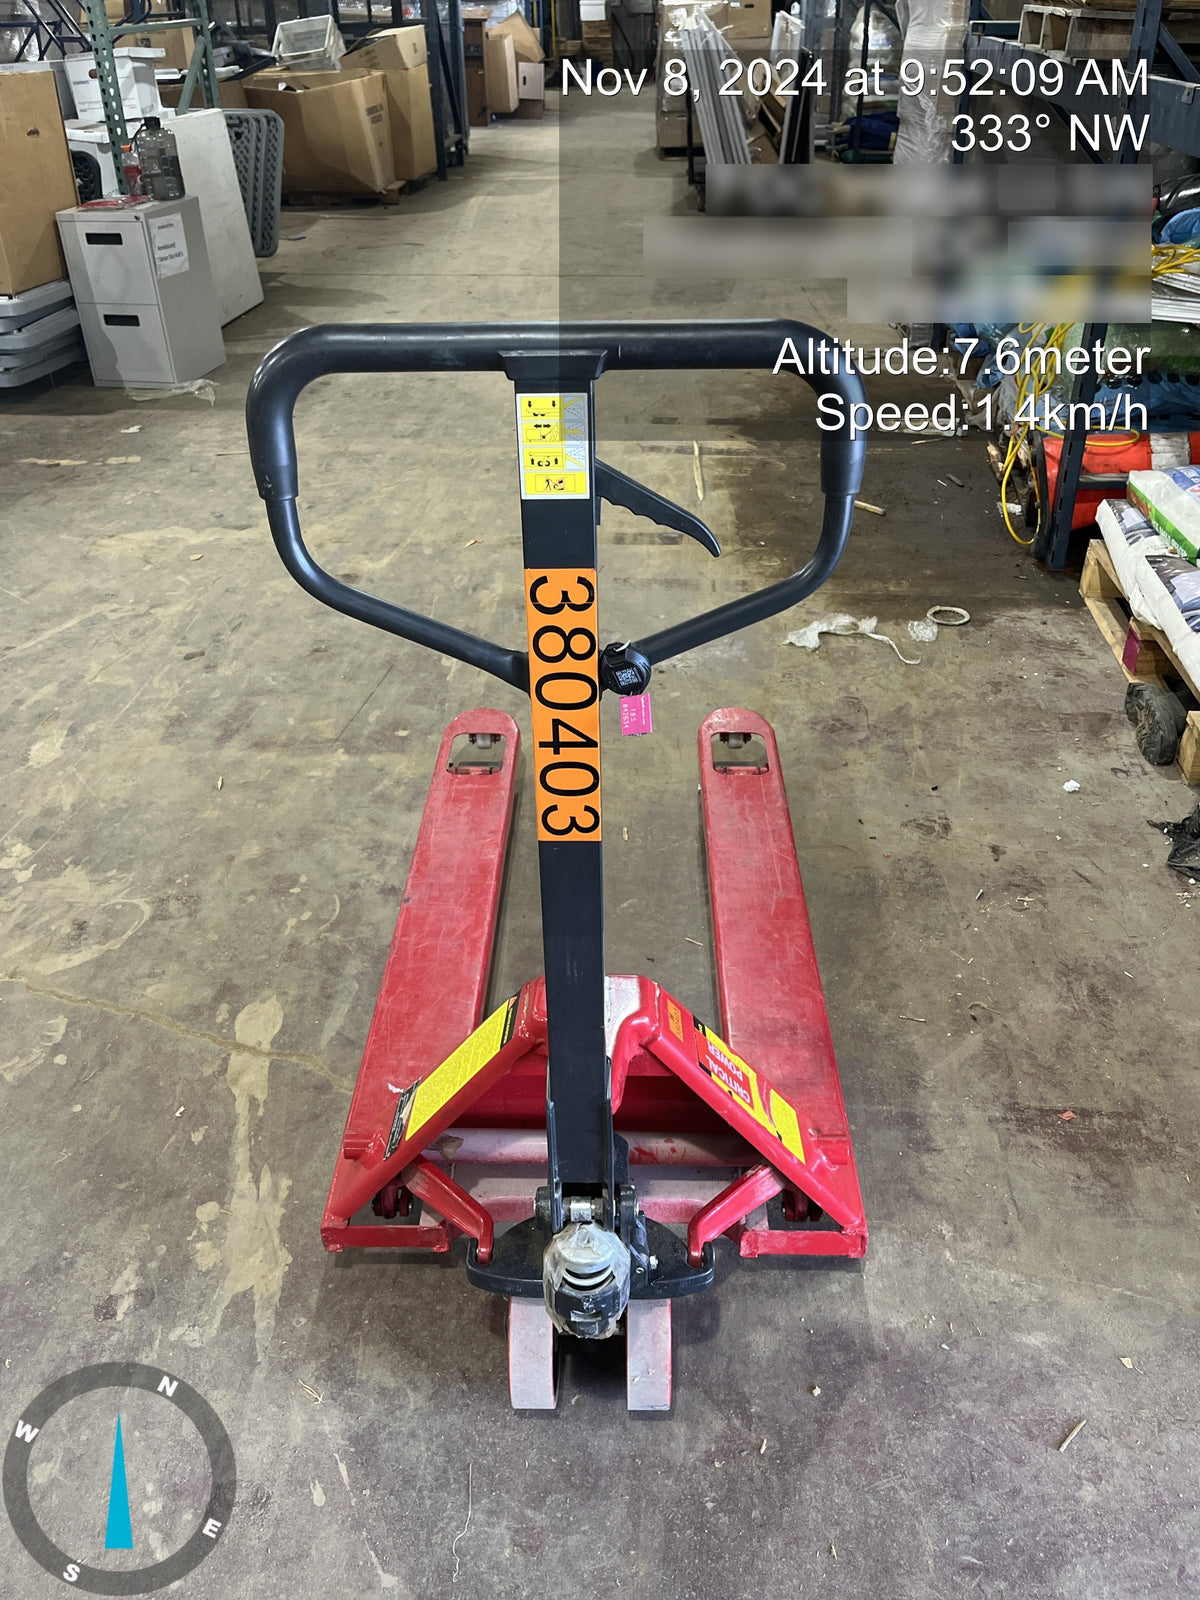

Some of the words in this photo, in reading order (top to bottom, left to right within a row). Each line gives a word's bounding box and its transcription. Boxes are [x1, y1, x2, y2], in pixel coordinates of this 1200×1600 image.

[529, 575, 600, 836] 380403
[705, 1054, 751, 1104] CRITICAL
[707, 1040, 744, 1081] POWER
